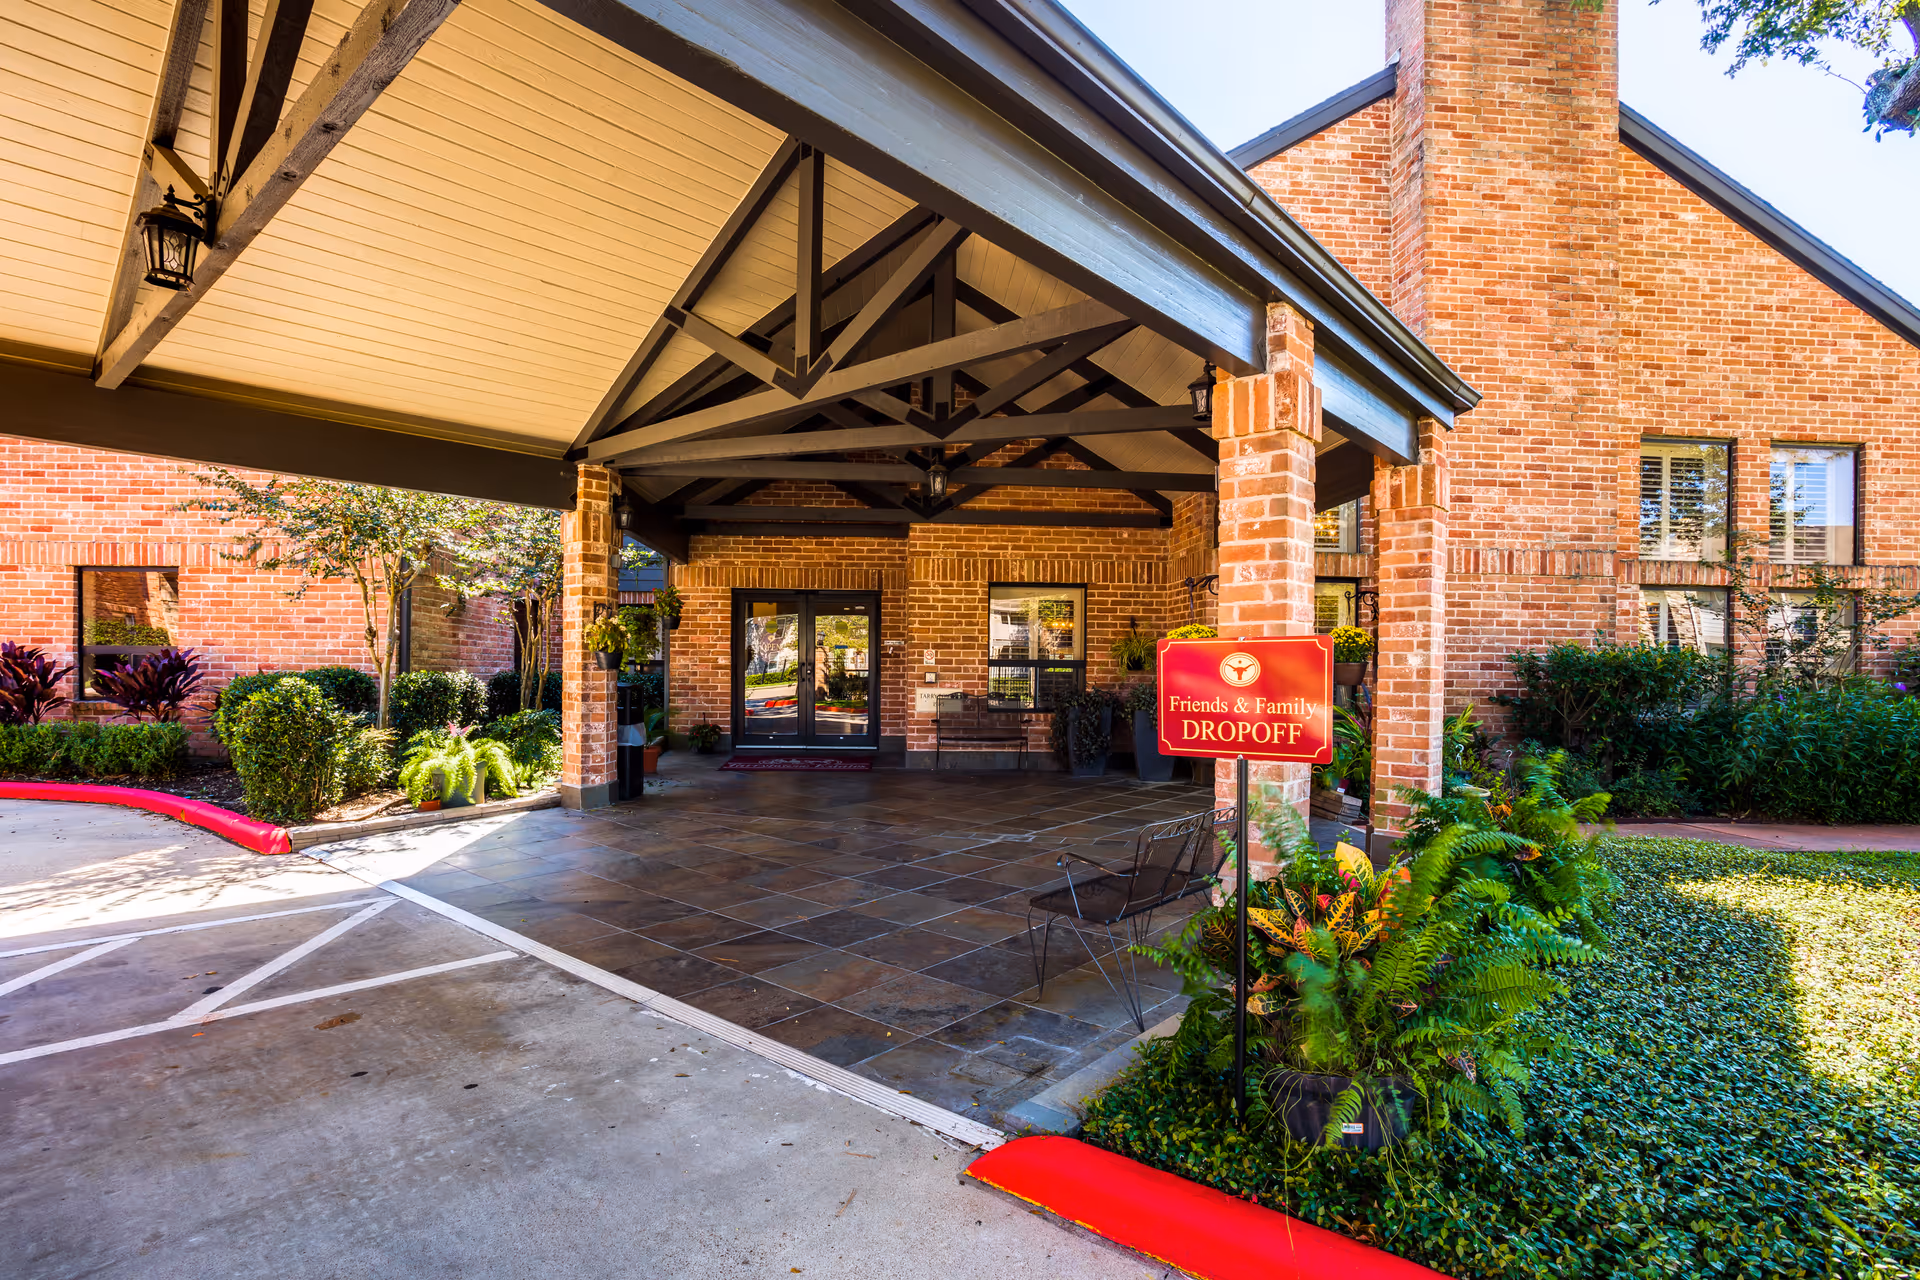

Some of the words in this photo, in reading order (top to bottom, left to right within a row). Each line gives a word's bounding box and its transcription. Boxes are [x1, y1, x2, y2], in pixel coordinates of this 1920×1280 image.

[1169, 696, 1229, 713] Friends
[1233, 697, 1250, 713] &
[1255, 697, 1317, 719] Family
[1182, 719, 1303, 744] DROPOFF
